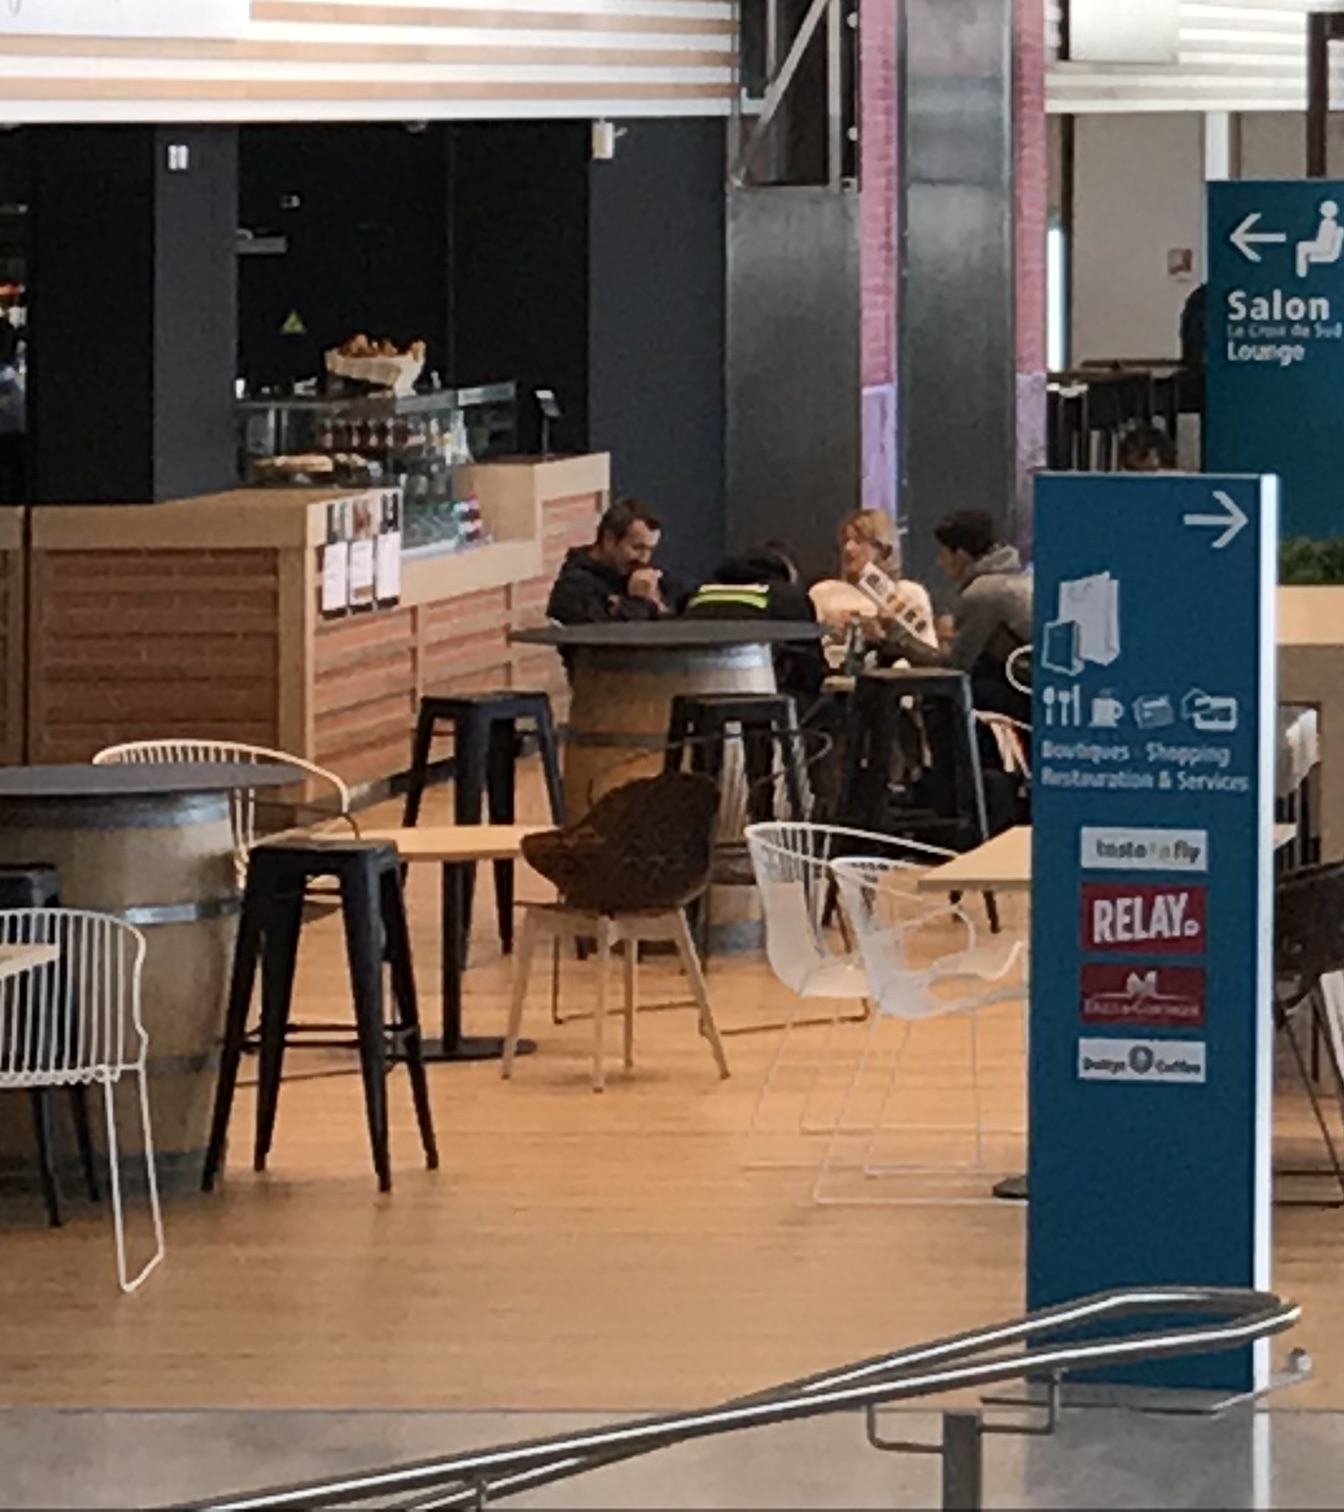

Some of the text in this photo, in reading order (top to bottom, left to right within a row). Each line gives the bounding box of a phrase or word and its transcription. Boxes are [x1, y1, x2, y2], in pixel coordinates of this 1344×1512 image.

[1227, 288, 1330, 321] Salon
[1313, 322, 1343, 338] Sud
[1227, 340, 1305, 366] Lounge
[1041, 740, 1231, 768] Boutiques Shopping
[1041, 765, 1154, 789] Restauration
[1176, 770, 1250, 792] Services
[1093, 892, 1189, 944] RELAY
